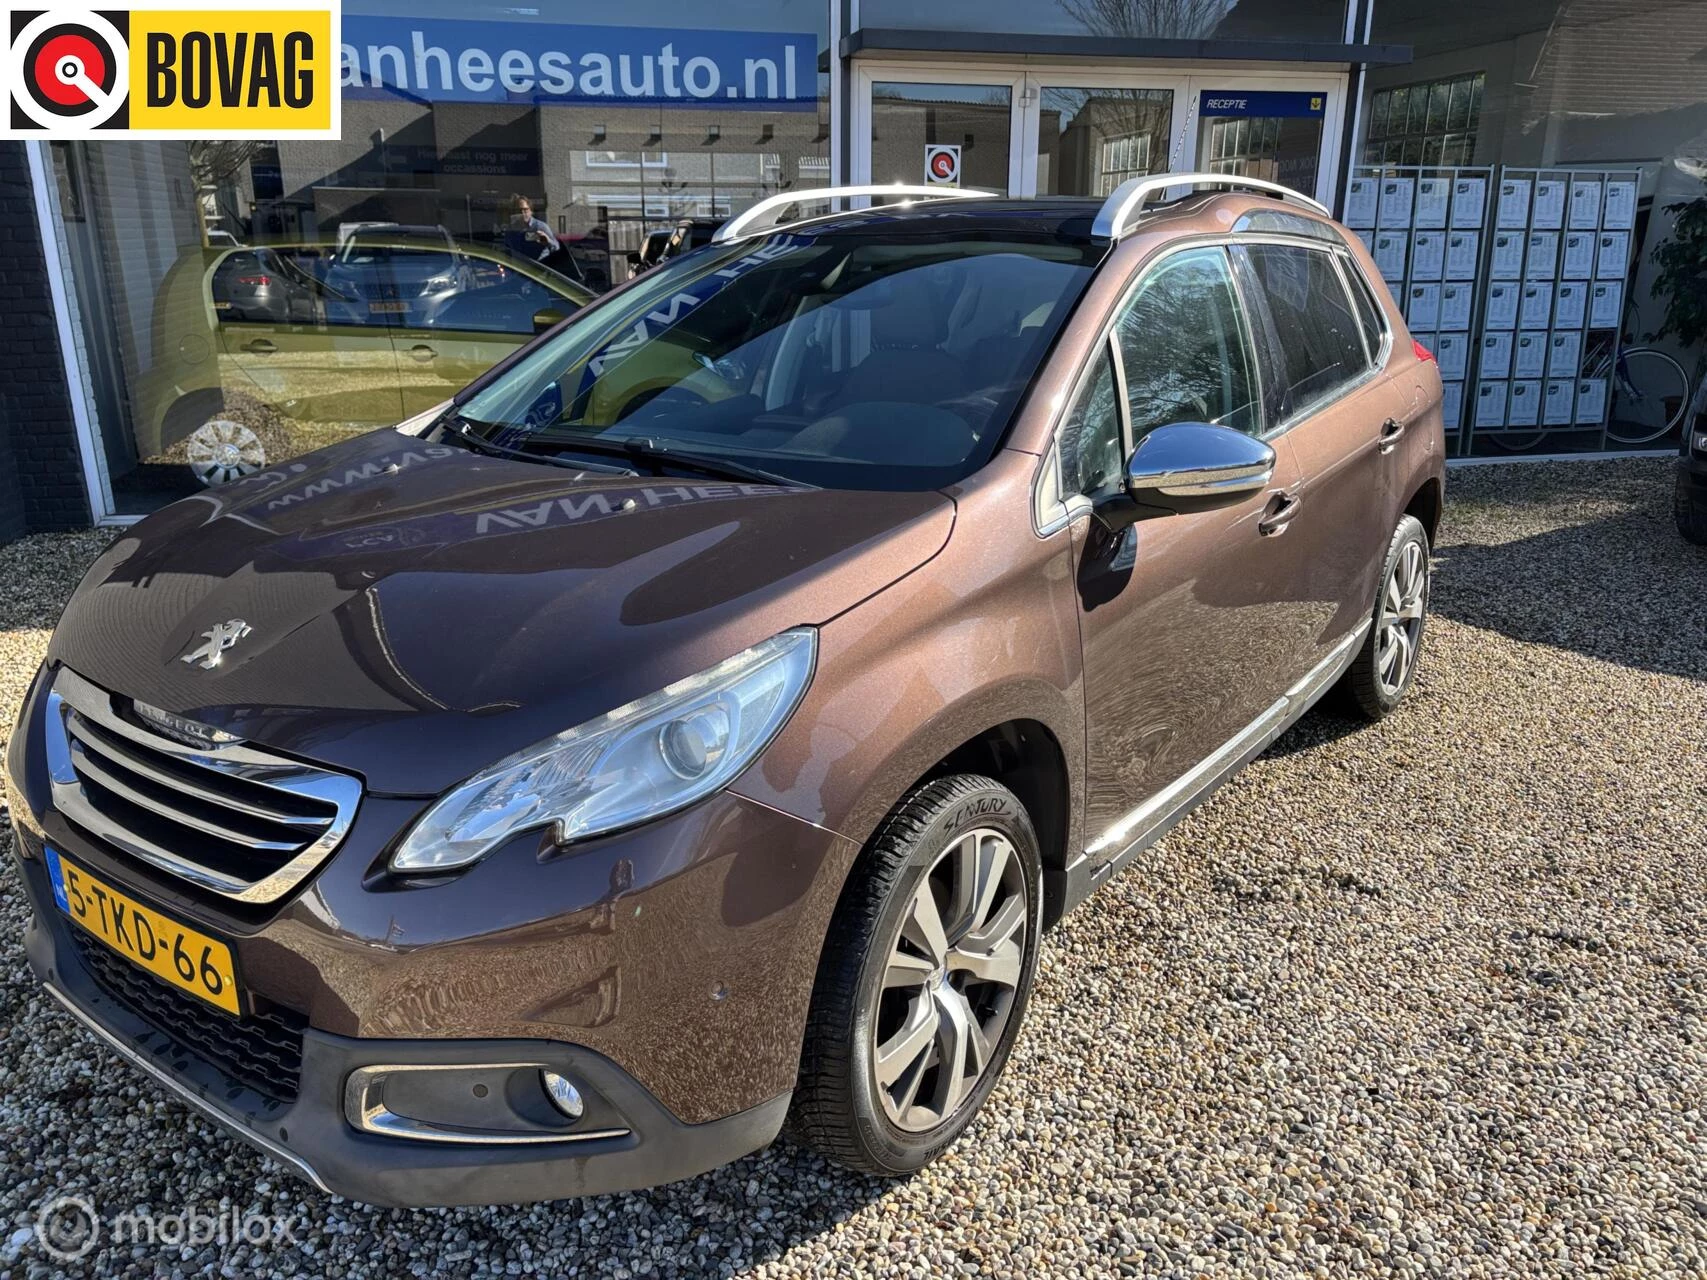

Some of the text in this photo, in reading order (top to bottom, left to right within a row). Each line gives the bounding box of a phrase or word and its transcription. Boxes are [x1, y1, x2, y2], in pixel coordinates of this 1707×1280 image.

[1206, 98, 1248, 109] RECEPTIE
[475, 151, 497, 163] nog
[500, 152, 529, 161] meer
[67, 868, 223, 996] 5-TKD-66
